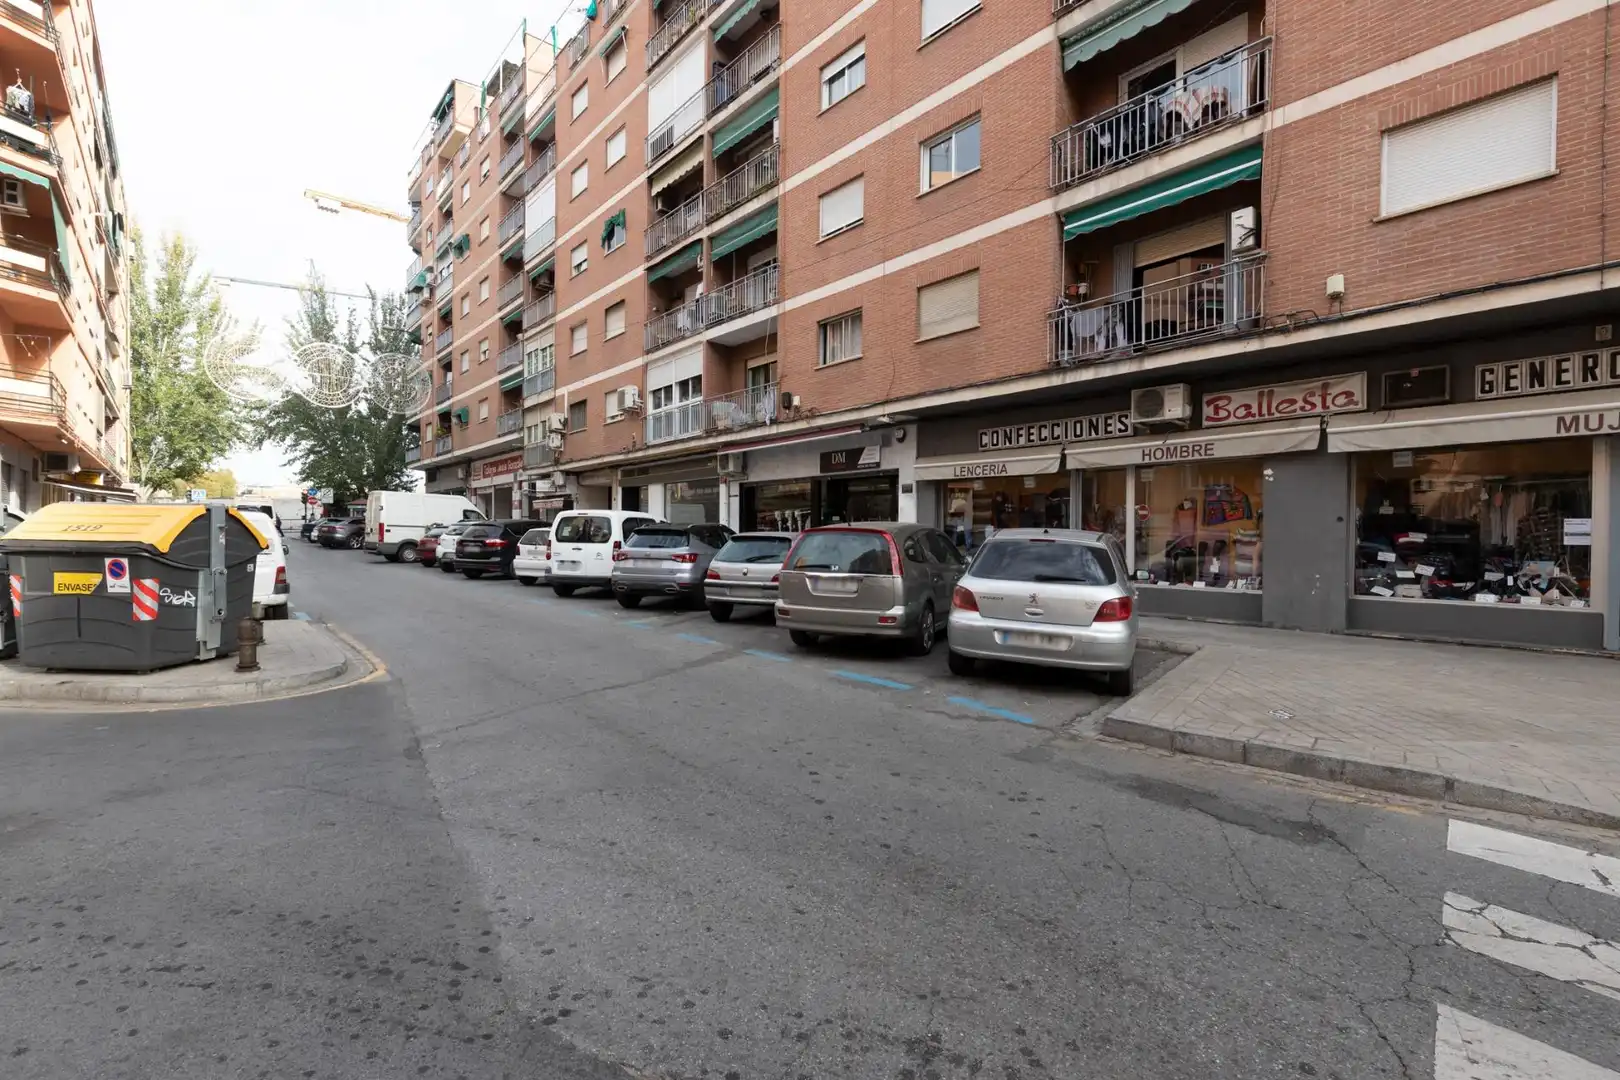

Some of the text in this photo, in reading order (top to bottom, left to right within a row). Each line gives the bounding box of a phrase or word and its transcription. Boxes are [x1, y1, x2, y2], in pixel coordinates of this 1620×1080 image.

[1204, 381, 1360, 423] Ballesta
[979, 413, 1129, 449] CONFECCIONES
[1556, 412, 1620, 434] MUJ
[1141, 442, 1215, 462] HOMBRE
[953, 463, 1008, 478] LENCERIA
[61, 524, 103, 533] 1519
